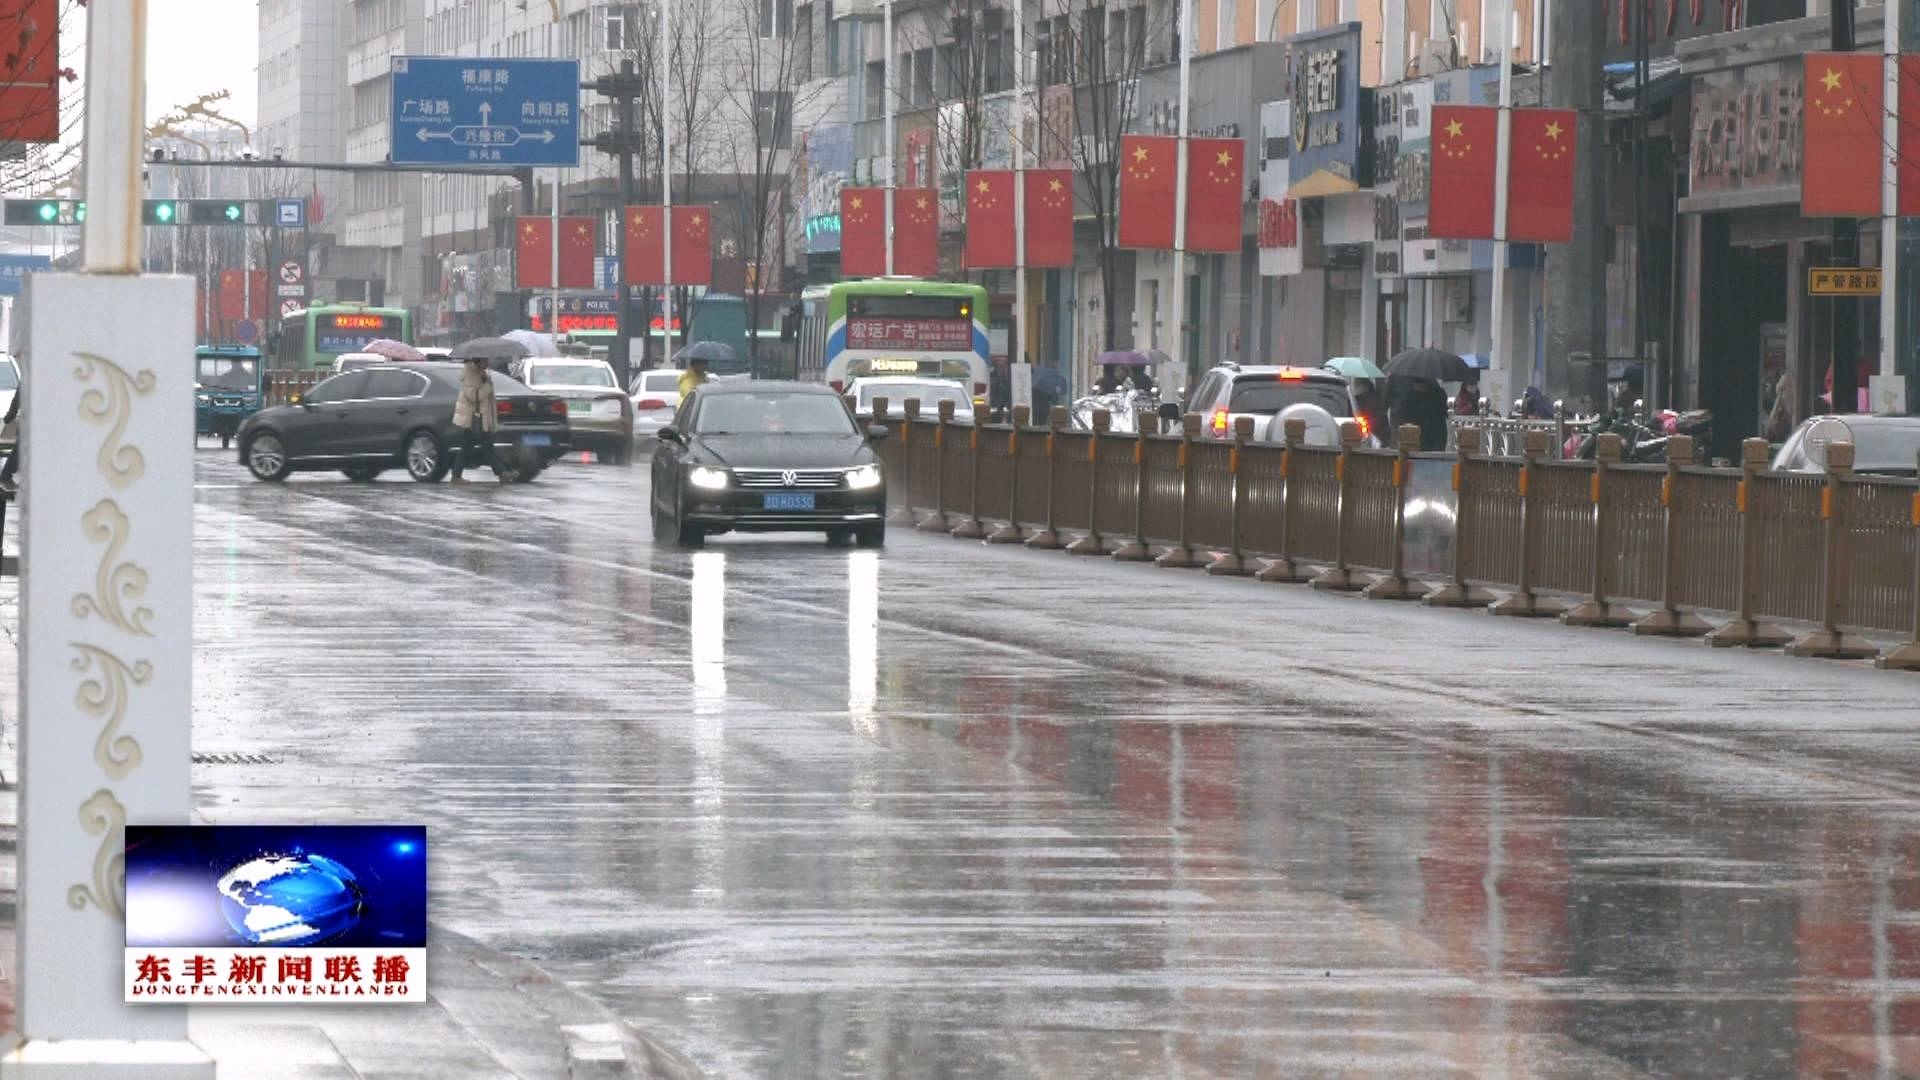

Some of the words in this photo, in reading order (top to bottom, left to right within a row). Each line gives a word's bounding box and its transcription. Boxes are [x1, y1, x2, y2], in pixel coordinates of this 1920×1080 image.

[462, 69, 509, 84] 福康路
[402, 99, 449, 114] 广场路
[522, 101, 568, 116] 向阳路
[1815, 274, 1879, 288] 严管路段
[586, 301, 609, 310] POLICE
[850, 321, 917, 338] 宏运广告
